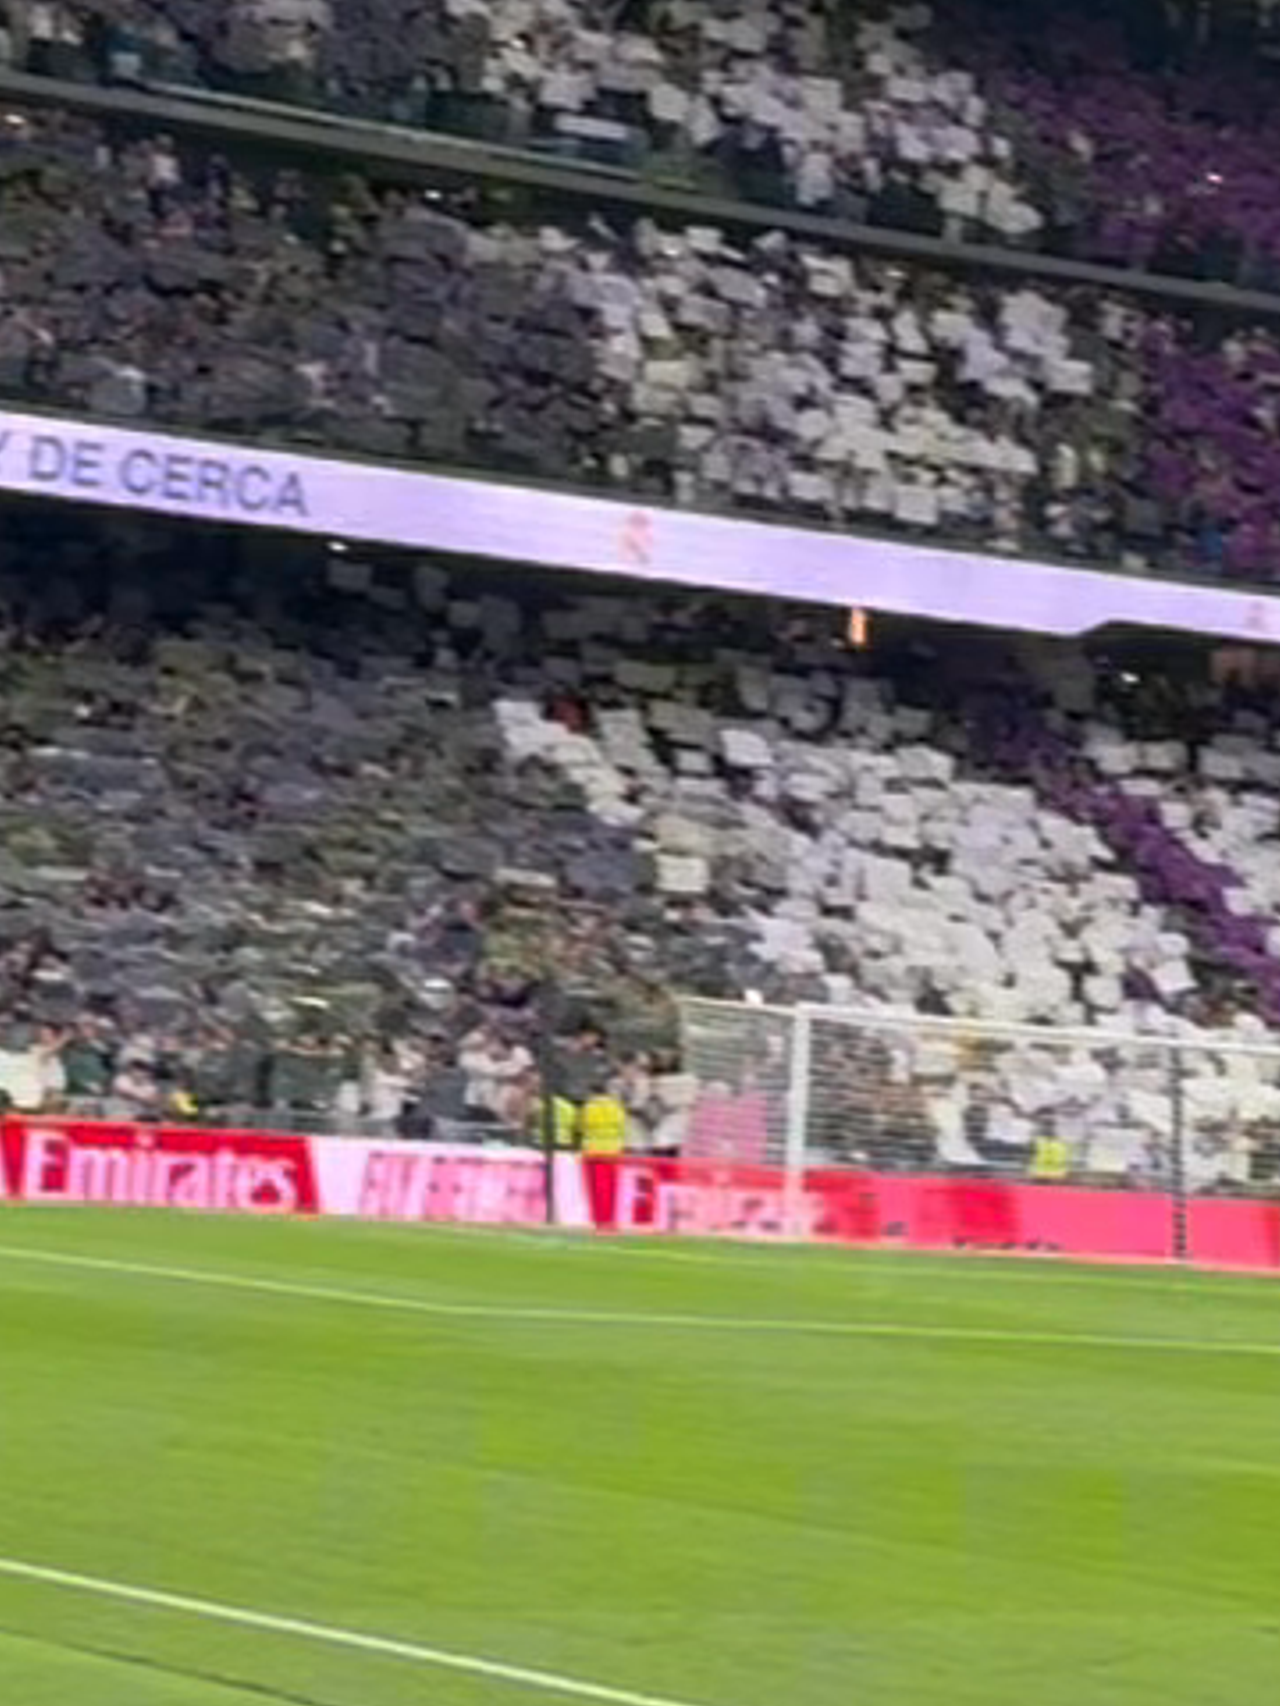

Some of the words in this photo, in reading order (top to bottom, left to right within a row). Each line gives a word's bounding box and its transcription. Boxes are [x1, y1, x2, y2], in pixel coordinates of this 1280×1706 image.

[27, 435, 104, 486] DE
[120, 449, 308, 517] CERCA
[23, 1129, 299, 1213] Emirates
